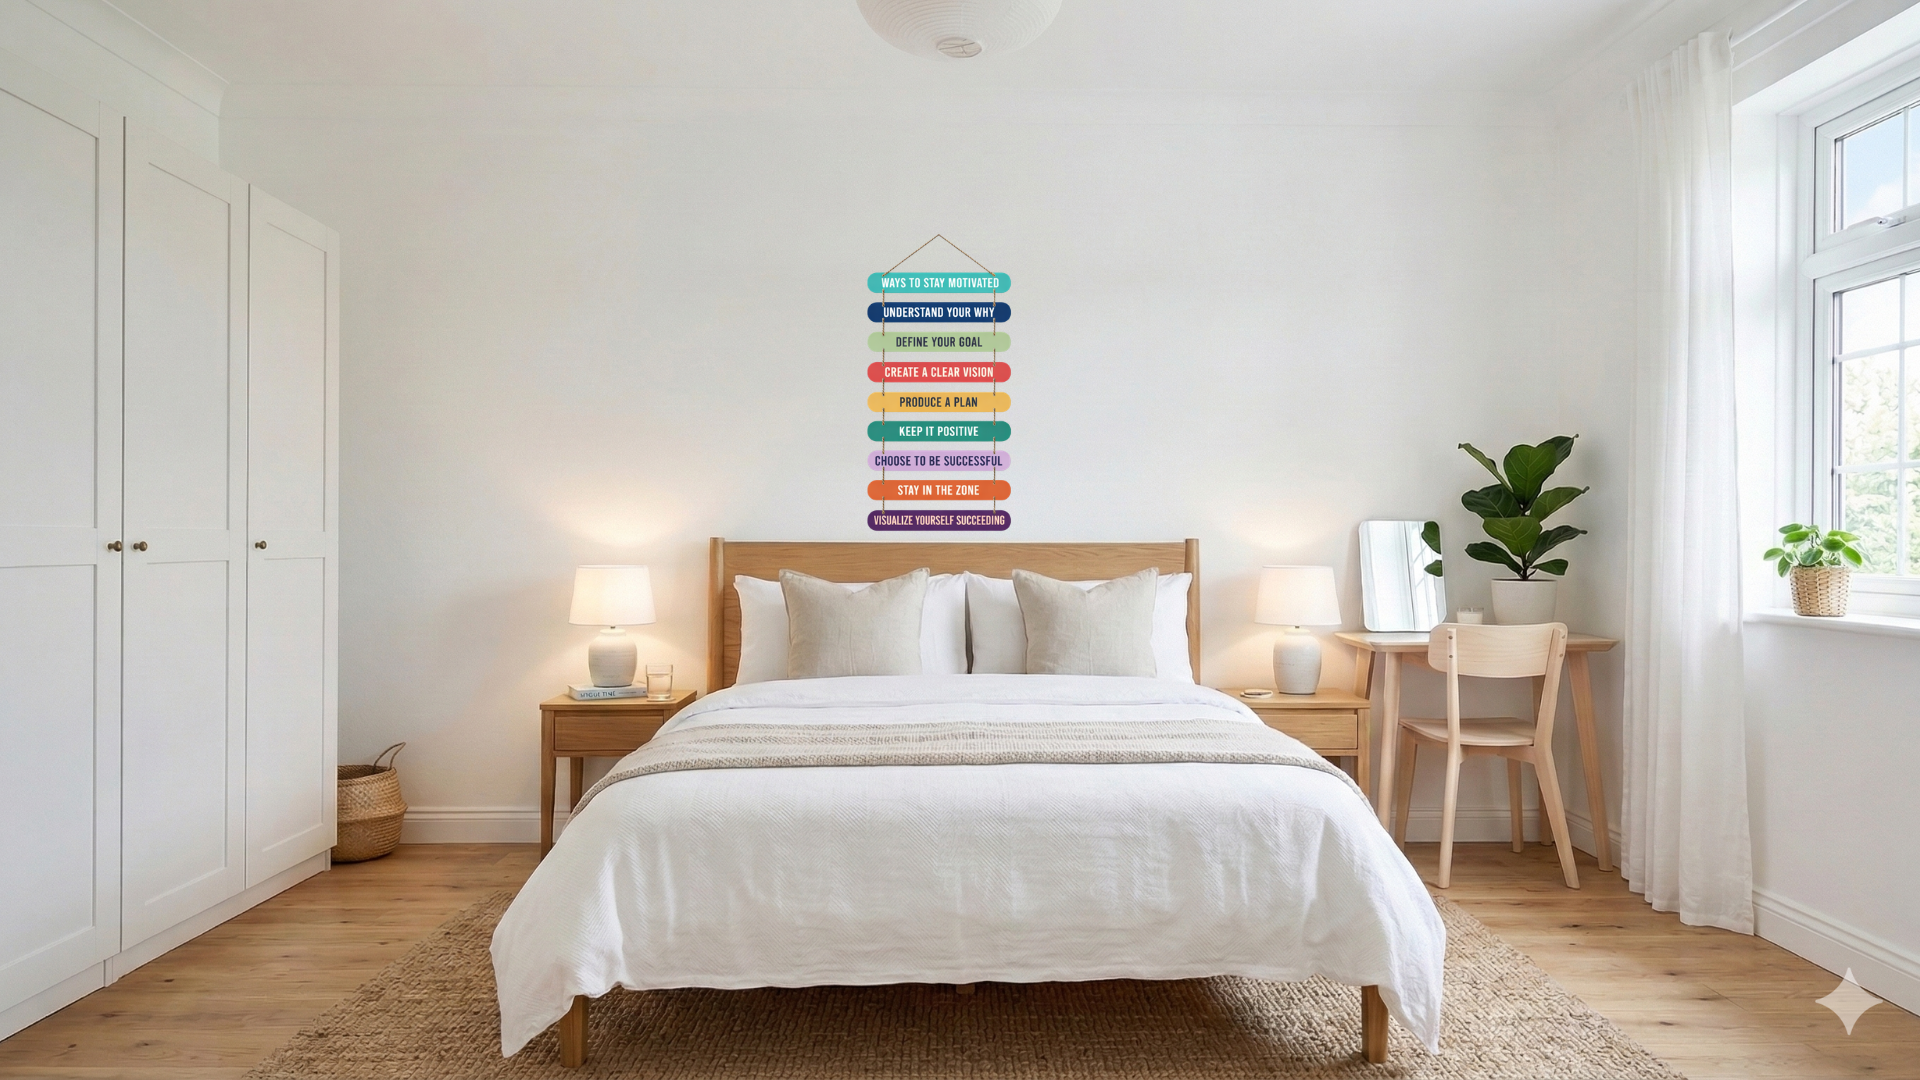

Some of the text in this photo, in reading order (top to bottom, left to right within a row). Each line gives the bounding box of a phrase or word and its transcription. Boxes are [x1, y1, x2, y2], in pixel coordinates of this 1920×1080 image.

[882, 278, 999, 288] WAYS TO STAY MOTIVATED
[884, 307, 994, 317] UNDERSTAND YOUR WHY
[896, 337, 982, 347] DEFINE YOUR GOAL
[885, 367, 993, 377] CREATE A CLEAR VISION
[900, 397, 977, 407] PRODUCE A PLAN
[899, 426, 978, 436] KEEP IT POSITIVE
[875, 456, 1002, 466] CHOOSE TO BE SUCCESSFUL
[898, 485, 979, 495] STAY IN THE ZONE
[874, 515, 1005, 525] VISUALIZE YOURSELF SUCCEEDING
